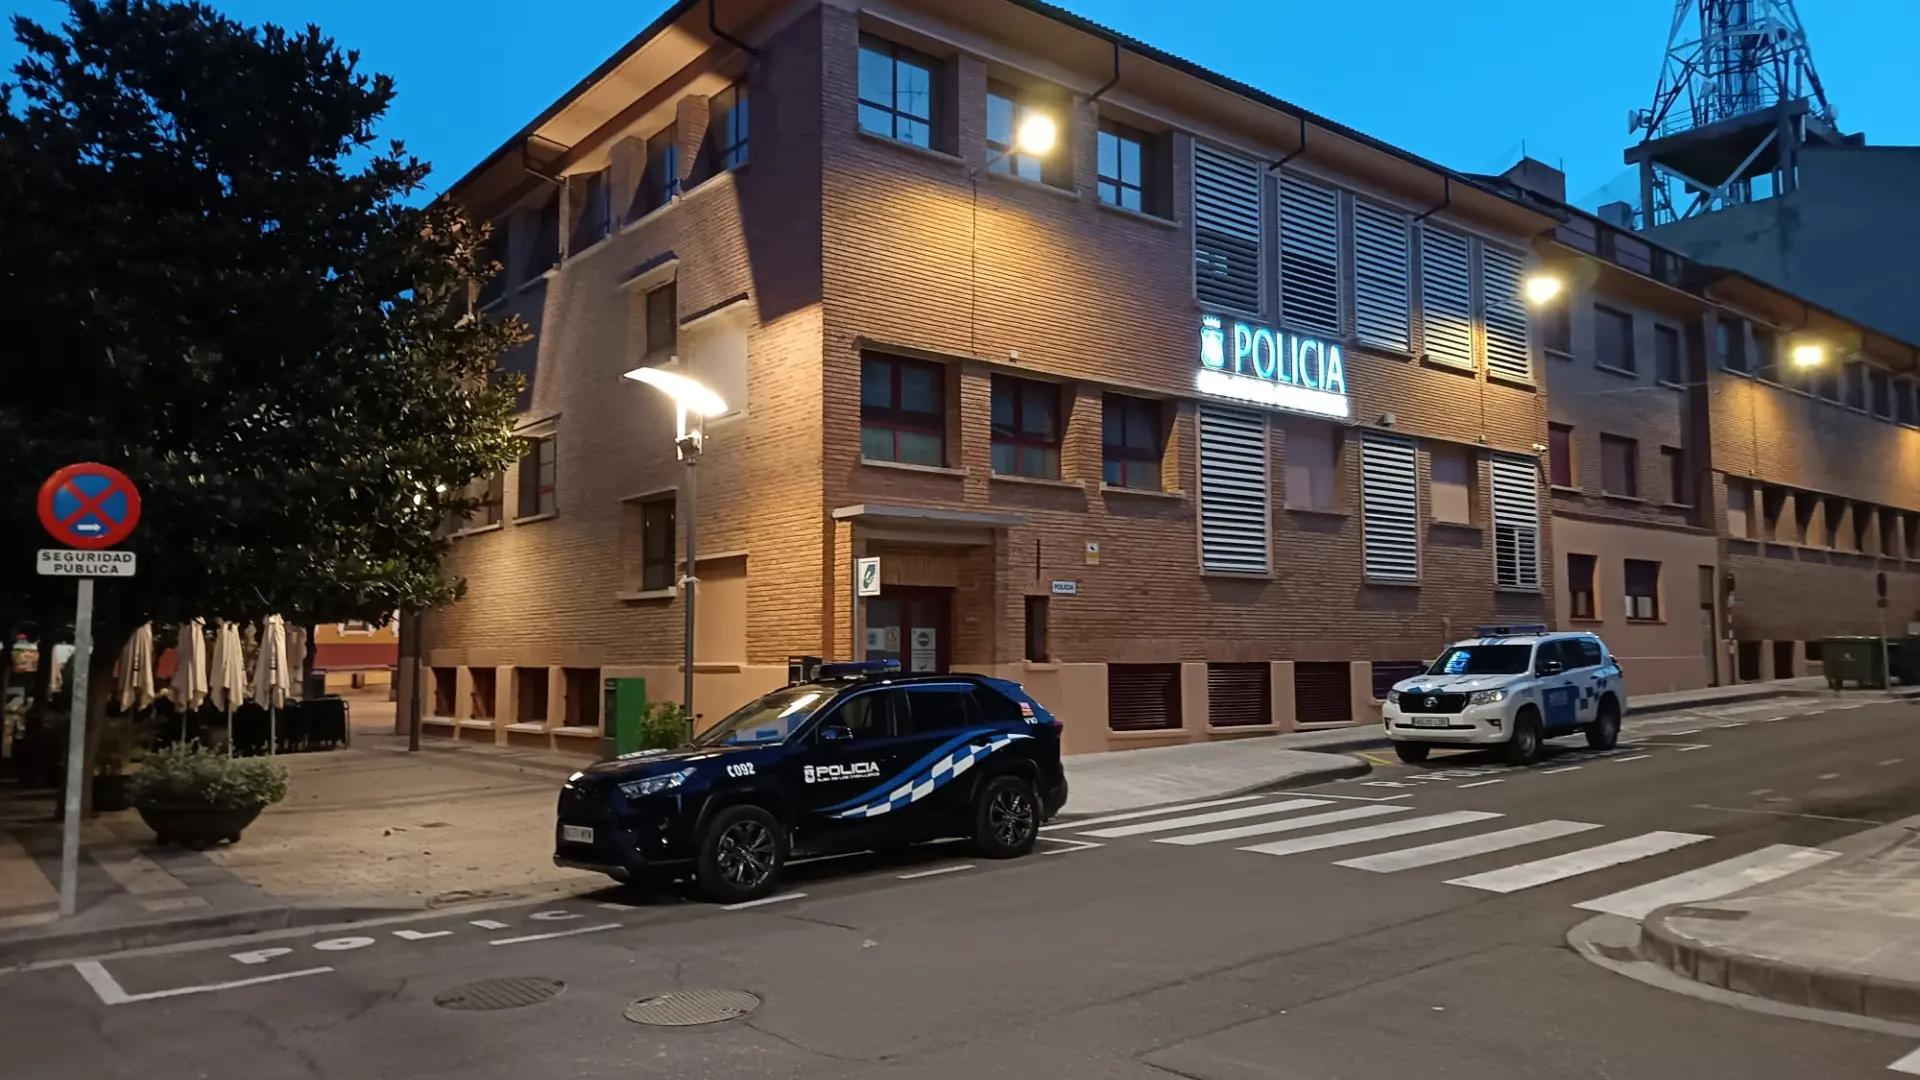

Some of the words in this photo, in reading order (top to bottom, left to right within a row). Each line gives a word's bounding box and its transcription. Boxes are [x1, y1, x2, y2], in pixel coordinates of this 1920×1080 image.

[1234, 322, 1346, 394] POLICIA
[42, 552, 132, 563] SEGURIDAD
[726, 762, 756, 778] C092
[816, 761, 879, 778] POLICIA
[229, 902, 640, 964] POLIC
